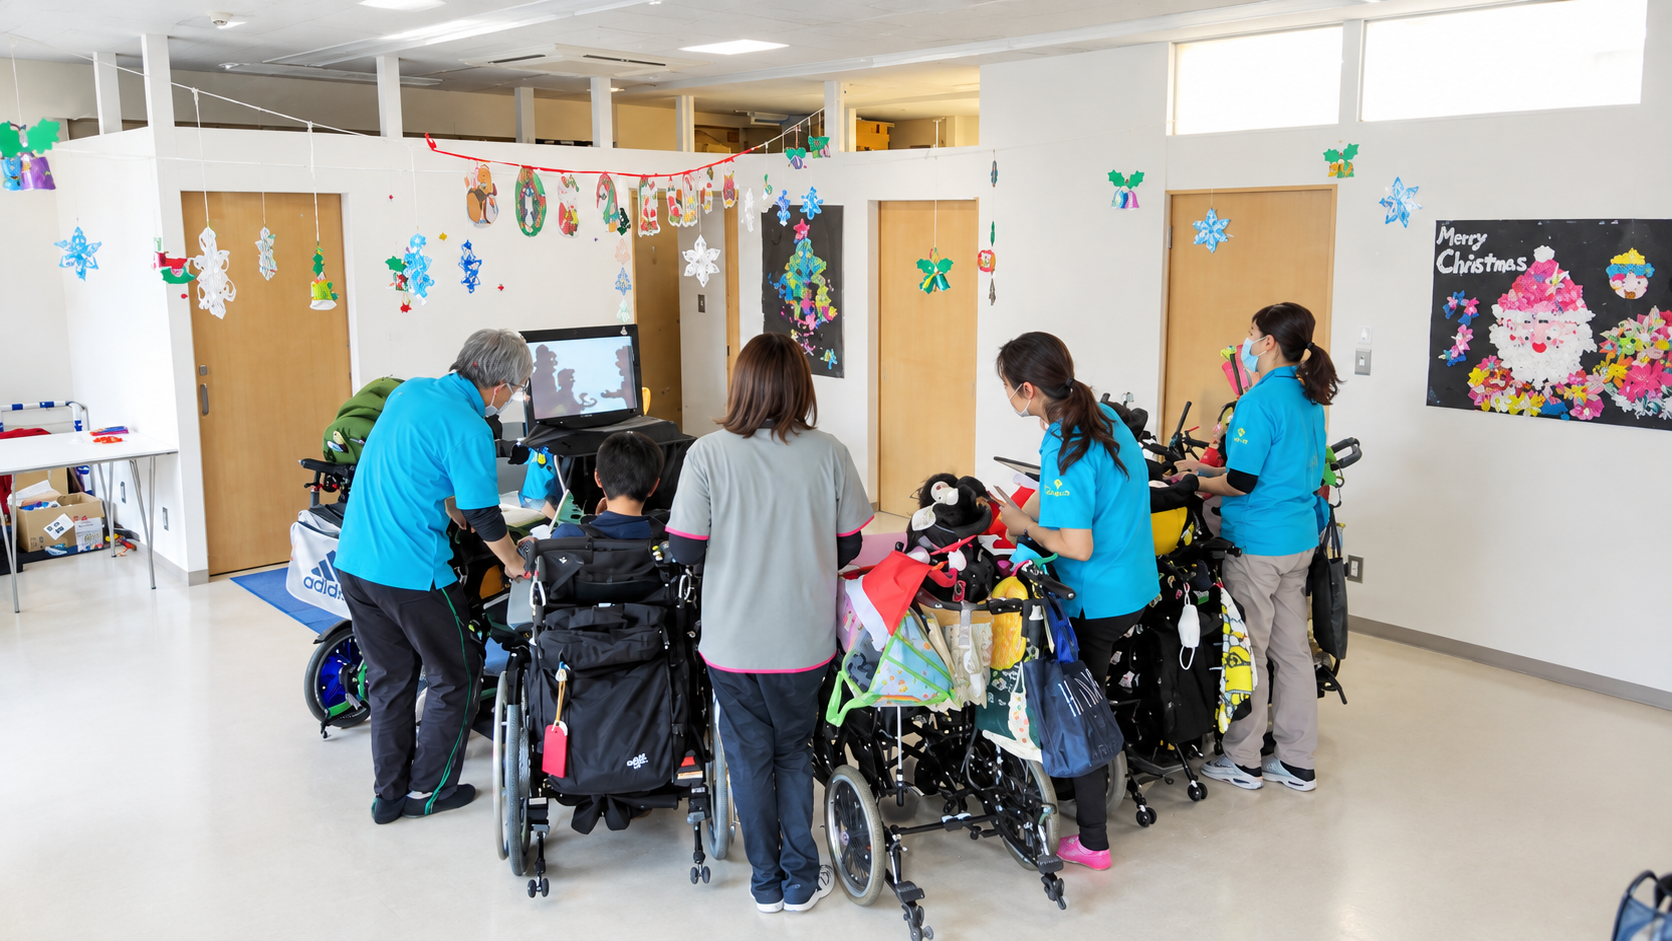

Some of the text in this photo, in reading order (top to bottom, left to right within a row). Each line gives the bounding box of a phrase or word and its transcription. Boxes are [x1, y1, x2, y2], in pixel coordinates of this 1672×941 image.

[1436, 226, 1488, 251] Merry
[1436, 249, 1528, 276] Christmas
[303, 576, 345, 602] adid
